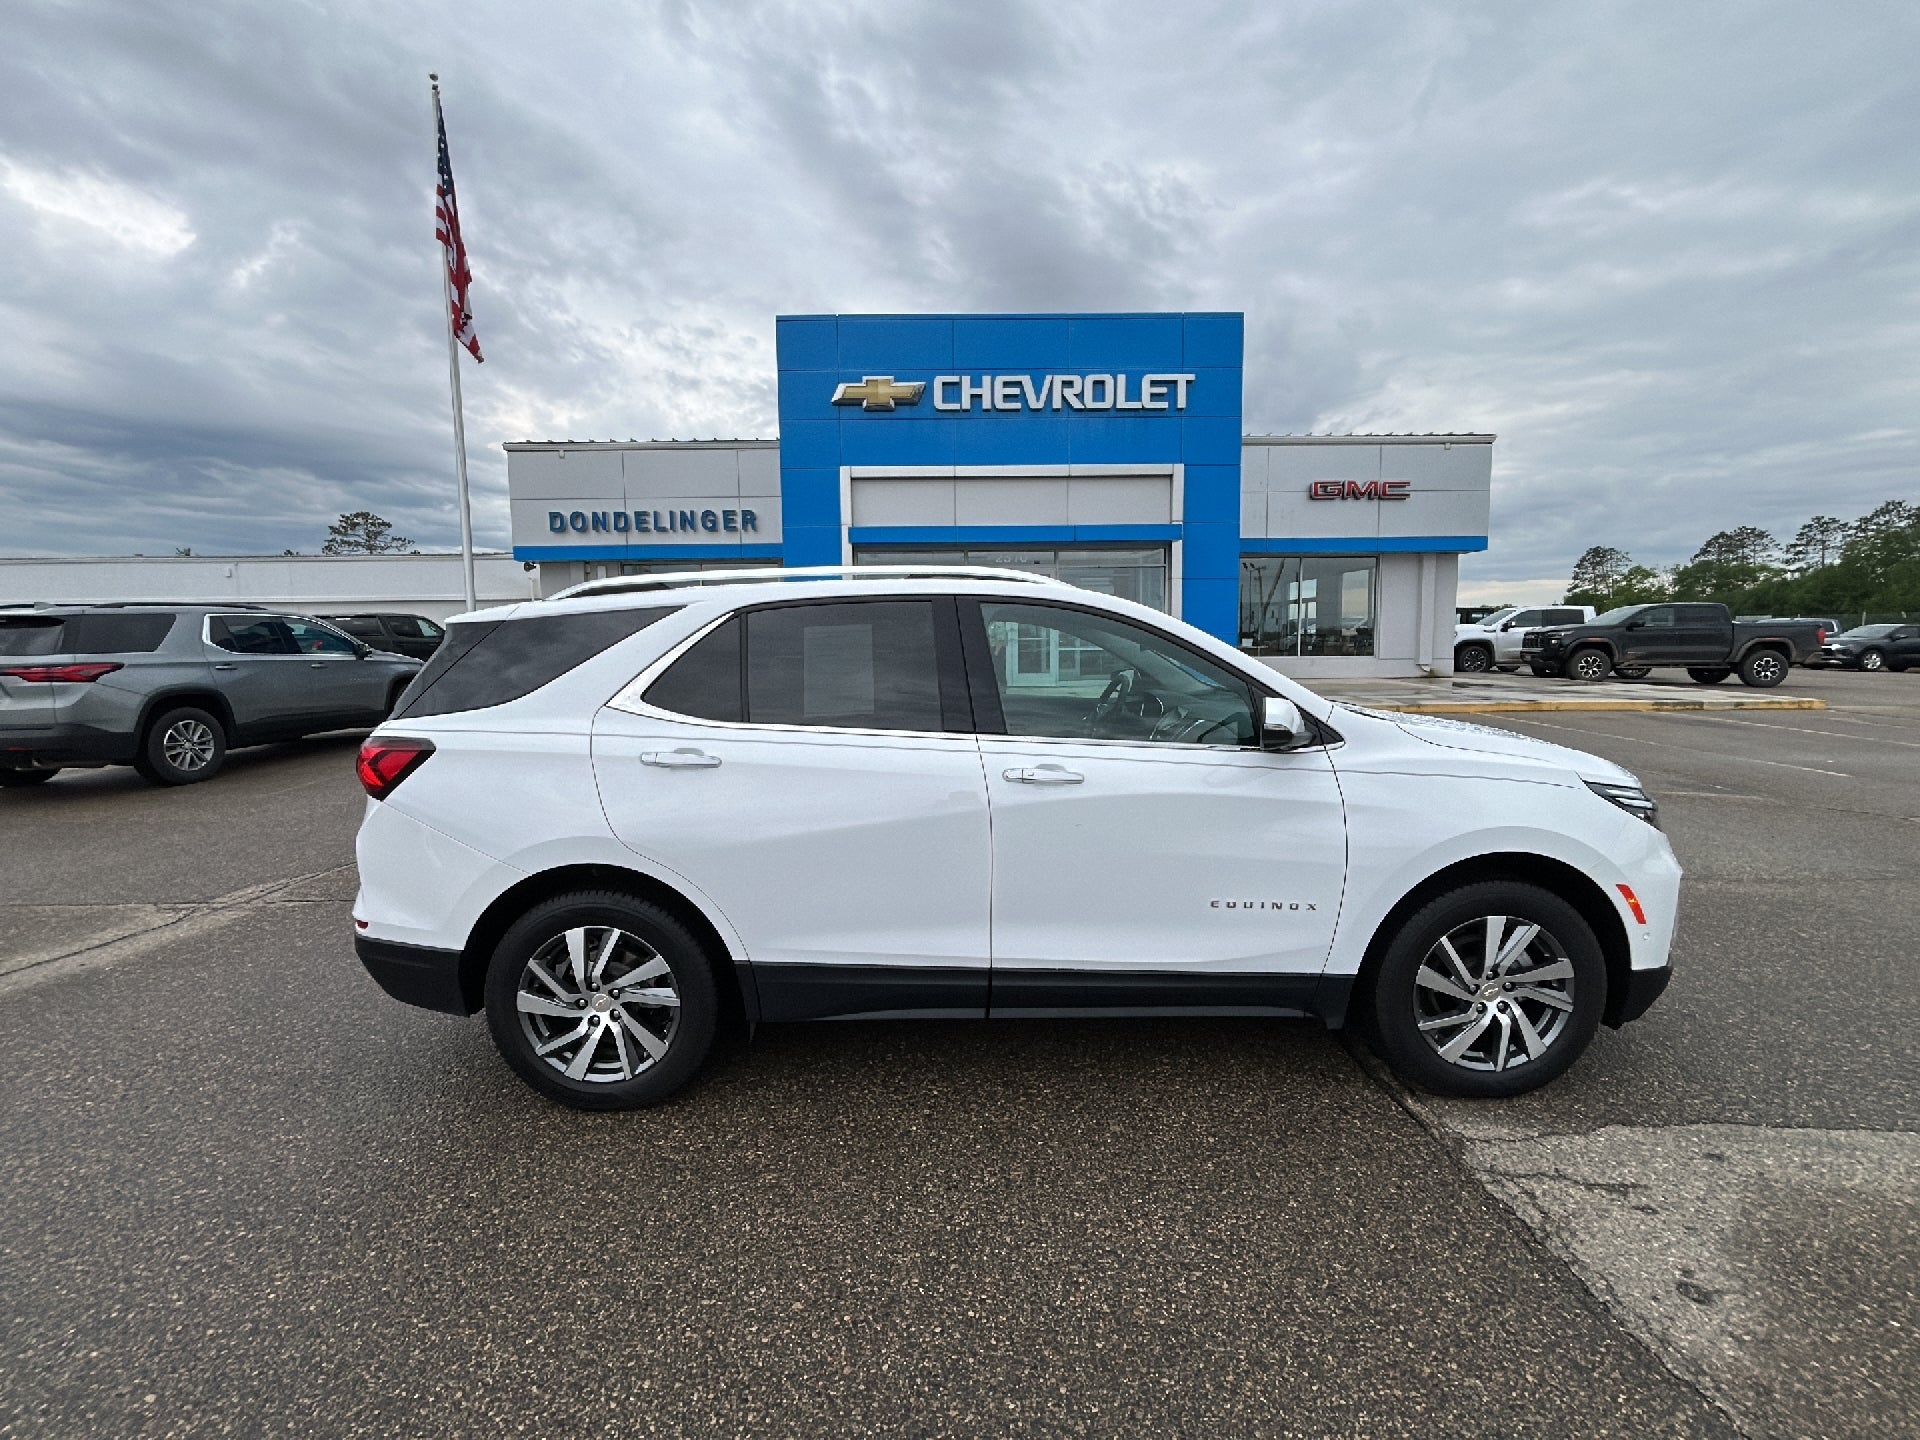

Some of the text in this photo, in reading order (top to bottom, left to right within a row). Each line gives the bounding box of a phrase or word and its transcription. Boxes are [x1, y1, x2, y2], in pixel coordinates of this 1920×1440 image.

[933, 374, 1196, 410] CHEVROLET
[1310, 480, 1411, 500] GMC
[549, 510, 757, 533] DONDELINGER
[1210, 900, 1317, 911] EQUINOX
